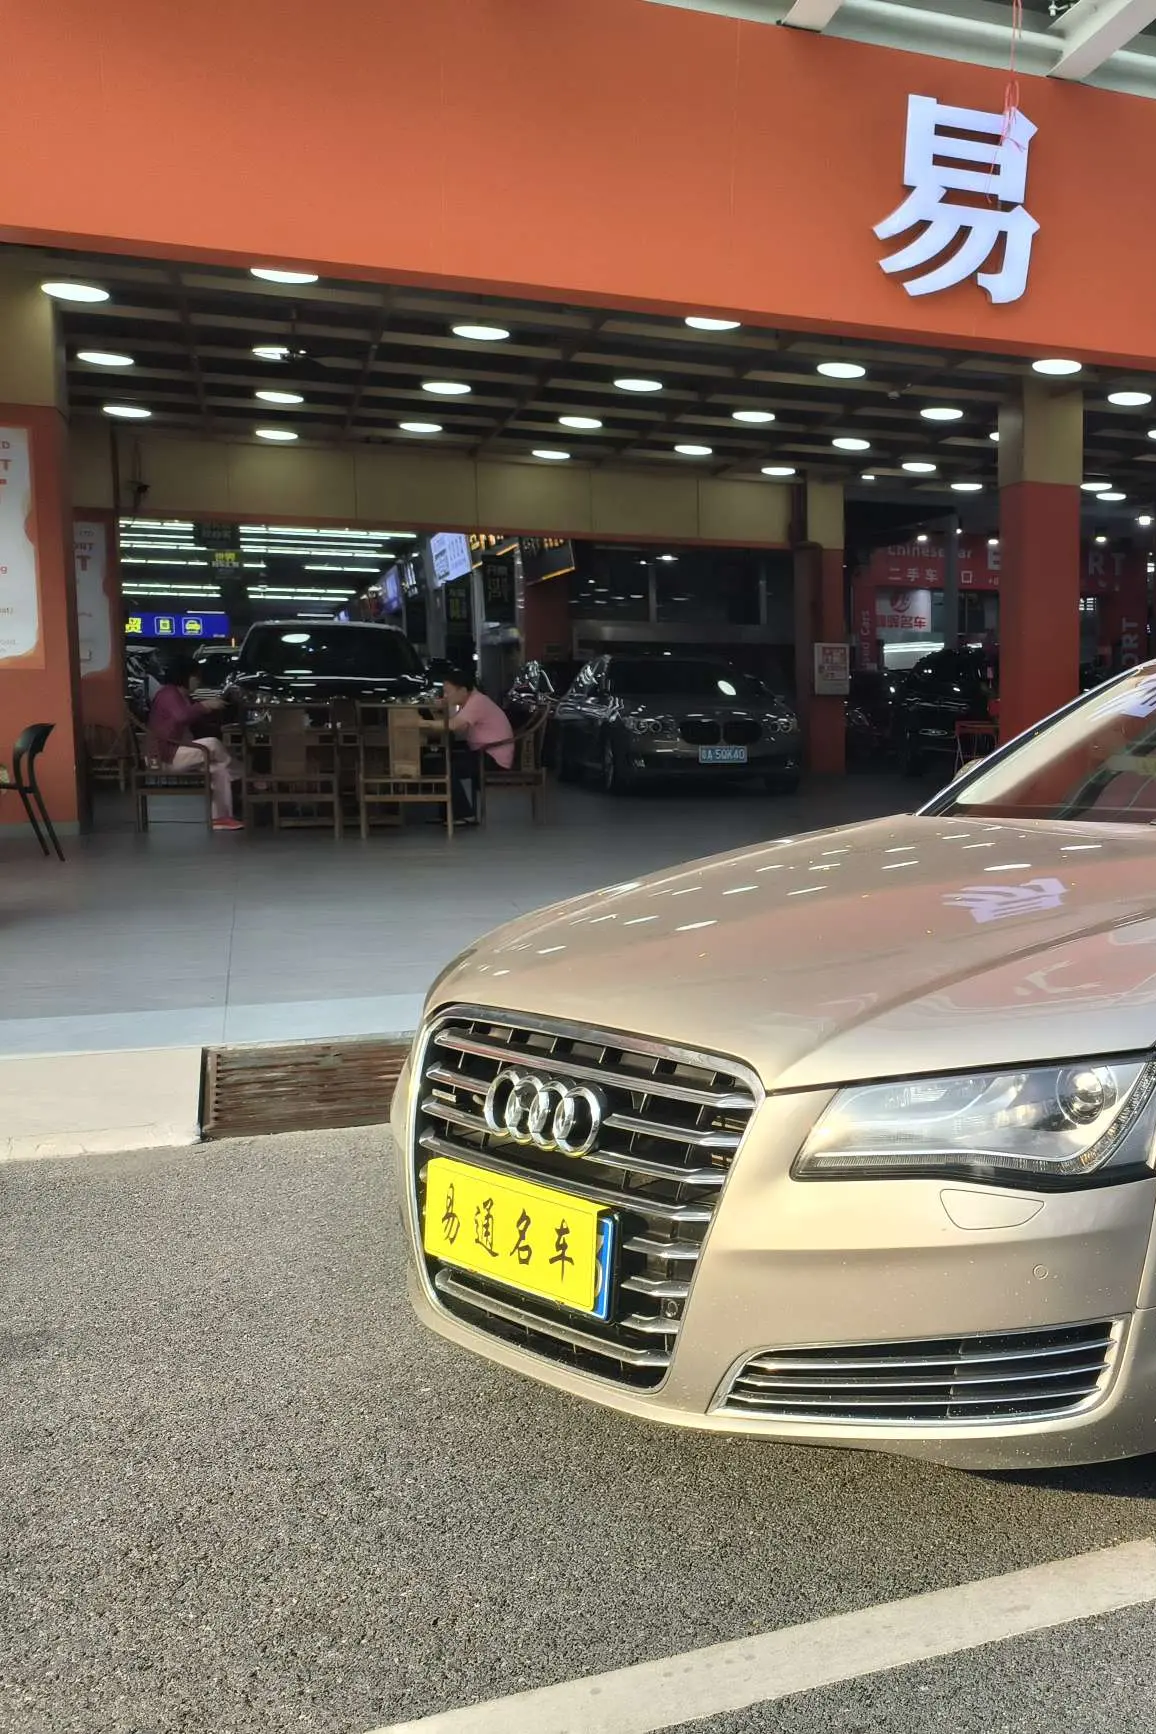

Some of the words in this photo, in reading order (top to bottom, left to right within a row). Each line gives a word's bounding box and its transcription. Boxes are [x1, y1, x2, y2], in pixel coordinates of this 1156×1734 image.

[888, 568, 973, 584] 二手车口
[441, 1183, 574, 1283] 易通名车
